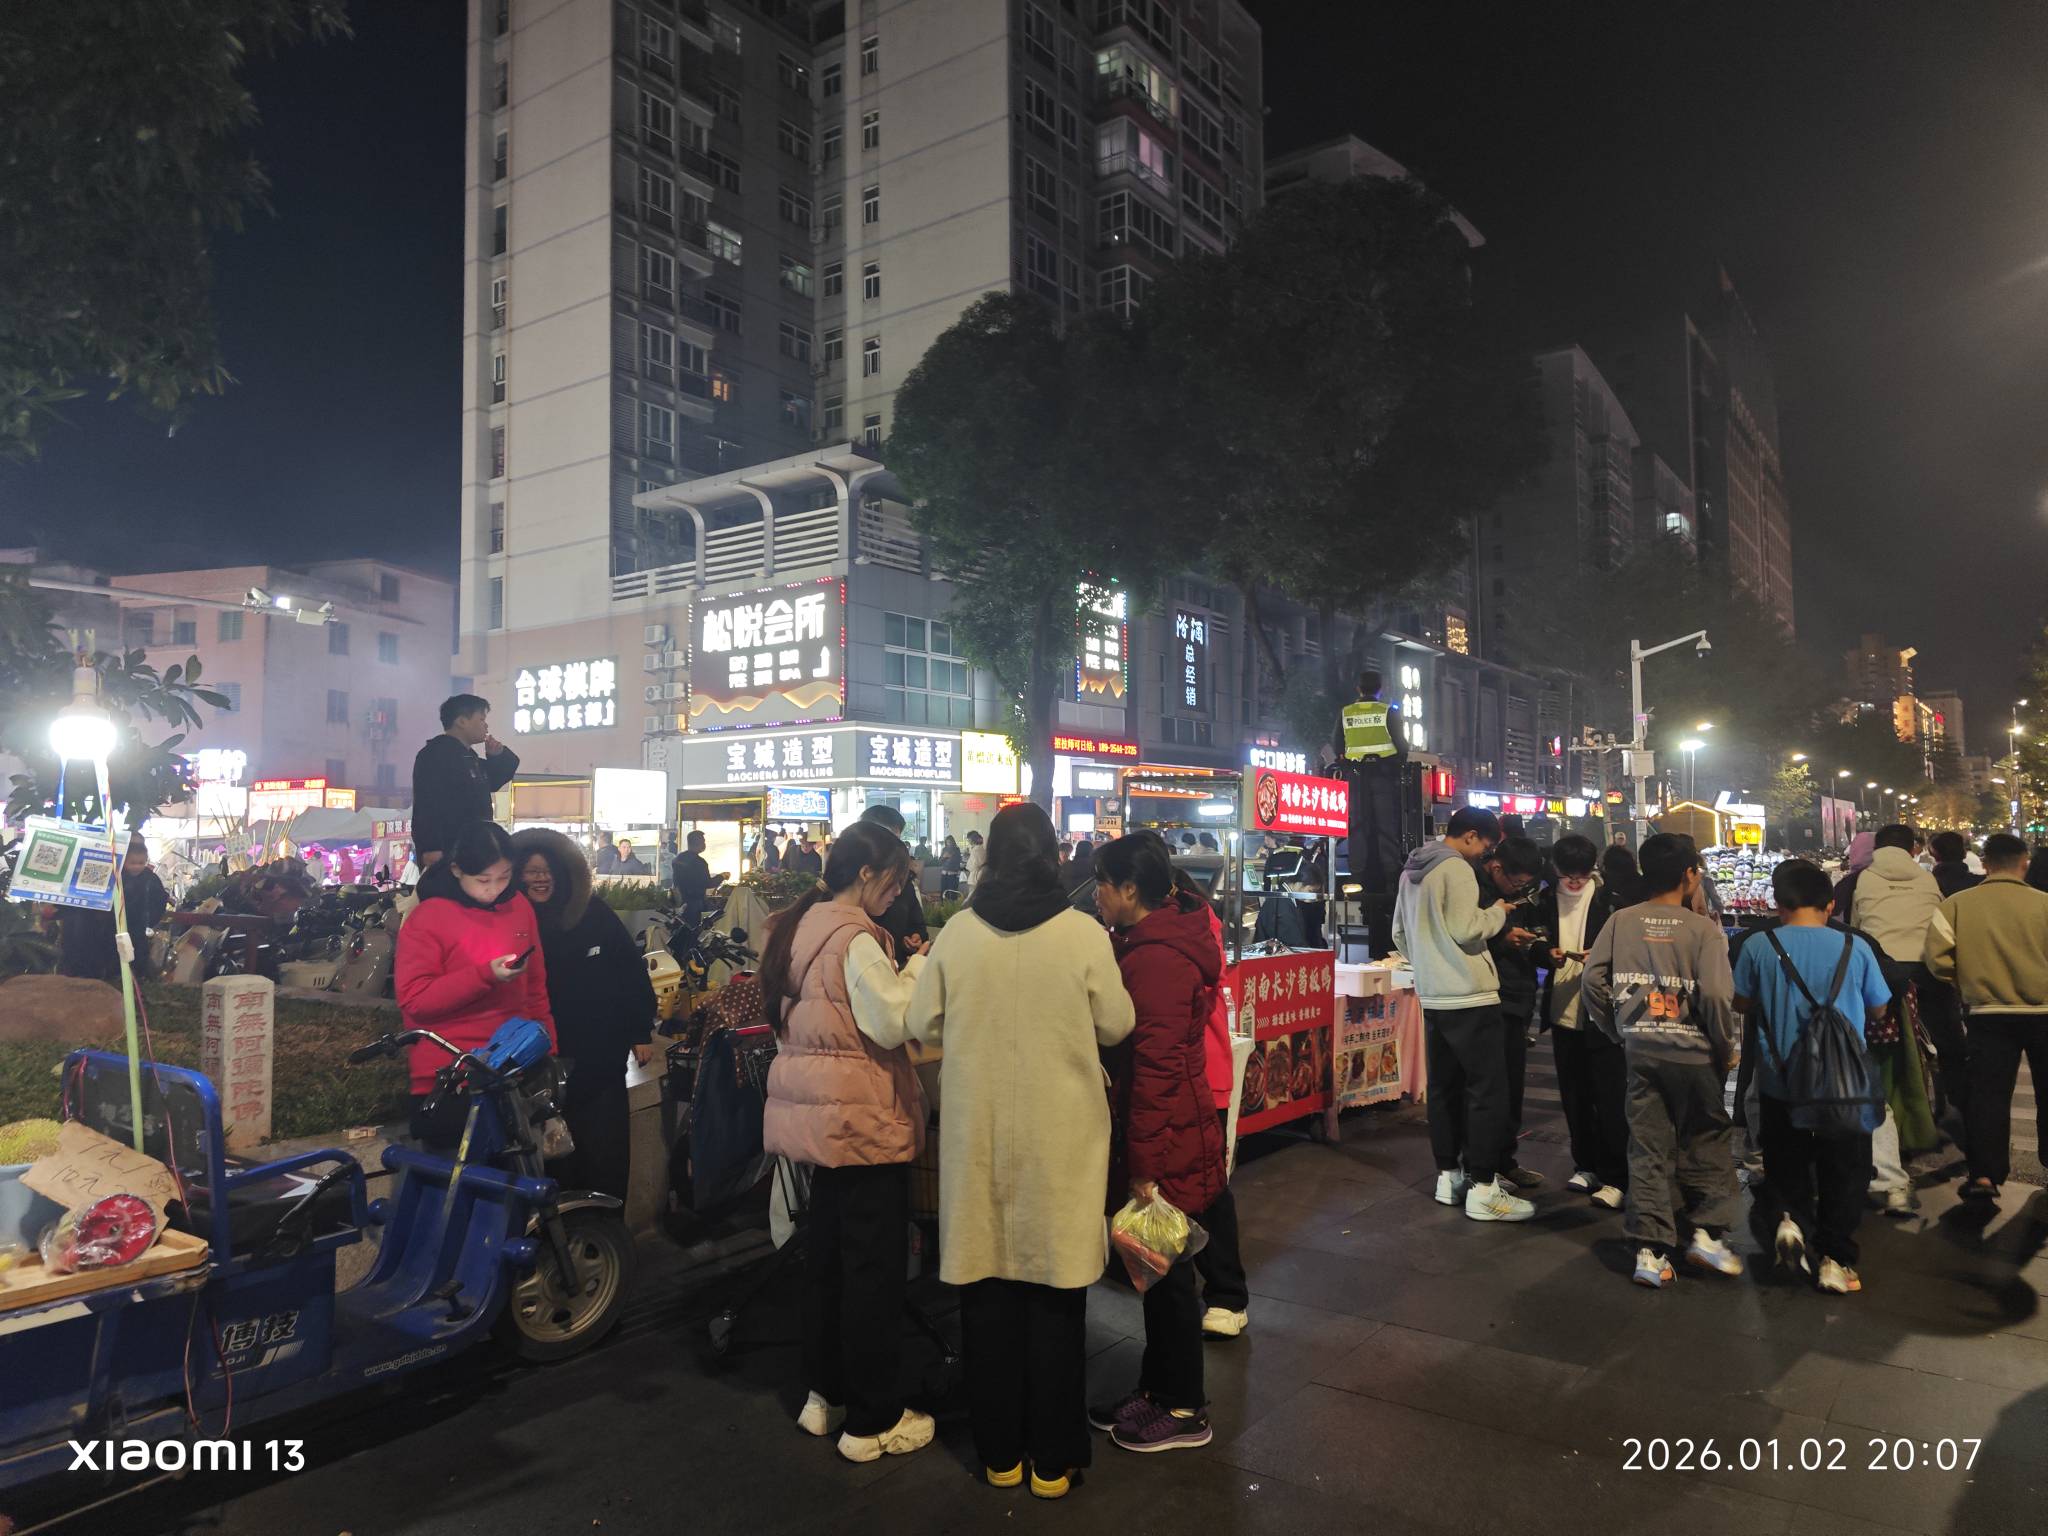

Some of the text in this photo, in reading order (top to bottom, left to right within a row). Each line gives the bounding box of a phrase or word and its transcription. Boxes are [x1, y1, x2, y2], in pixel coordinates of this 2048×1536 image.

[702, 591, 826, 653] 松悦会所
[515, 659, 615, 706] 台球棋牌
[727, 735, 833, 770] 宝城造型
[870, 735, 952, 768] 宝城造型
[727, 769, 779, 782] BAOCHENG
[1243, 964, 1332, 1006] 湖南长沙酱板鸭
